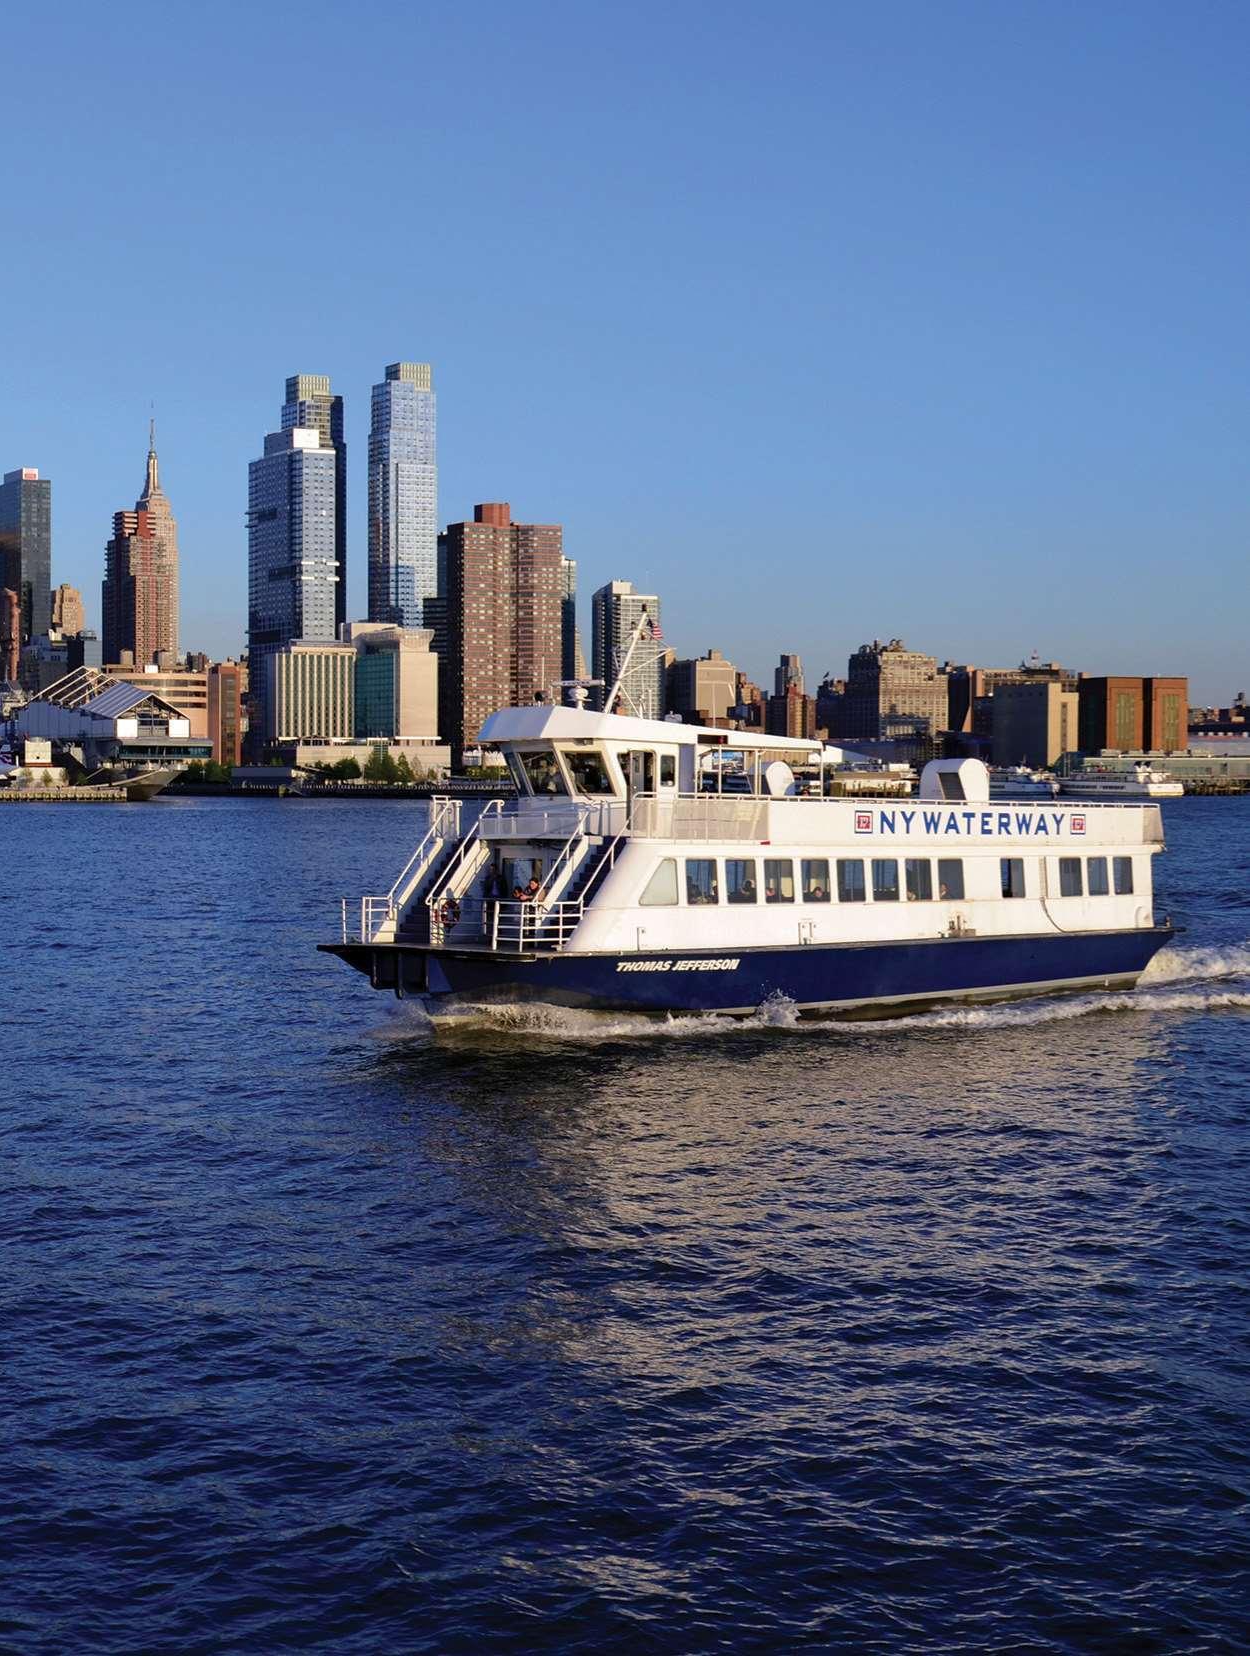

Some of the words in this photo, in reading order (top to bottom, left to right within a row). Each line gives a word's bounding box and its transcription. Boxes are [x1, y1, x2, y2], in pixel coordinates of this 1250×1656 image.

[880, 811, 916, 834] NY
[923, 811, 1065, 835] WATERWAY
[616, 961, 672, 972] THOMAS
[672, 959, 740, 971] JEFFERSON
